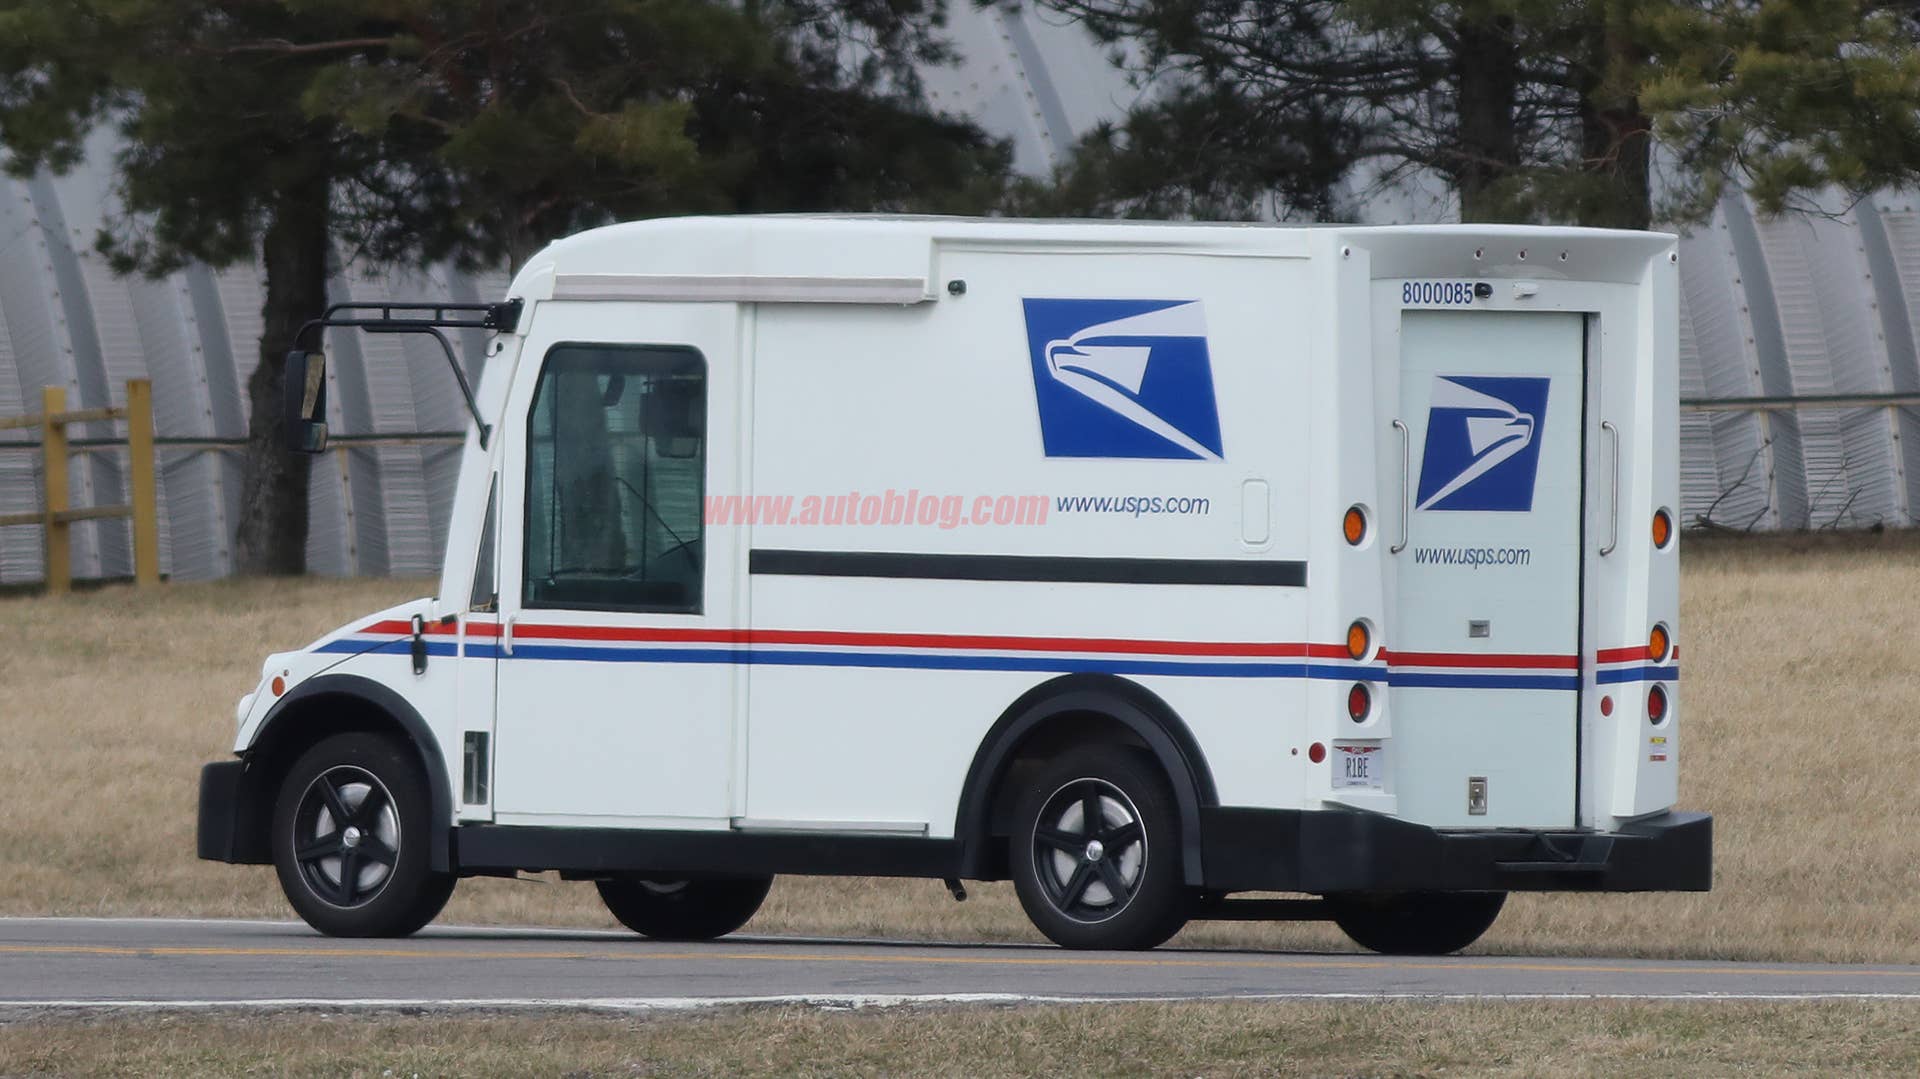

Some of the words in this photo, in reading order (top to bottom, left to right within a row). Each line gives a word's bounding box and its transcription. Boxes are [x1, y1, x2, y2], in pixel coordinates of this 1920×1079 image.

[1403, 282, 1473, 304] 8000085
[1057, 495, 1210, 517] www.usps.com
[1416, 547, 1531, 570] www.usps.com
[1346, 757, 1369, 778] R1BE
